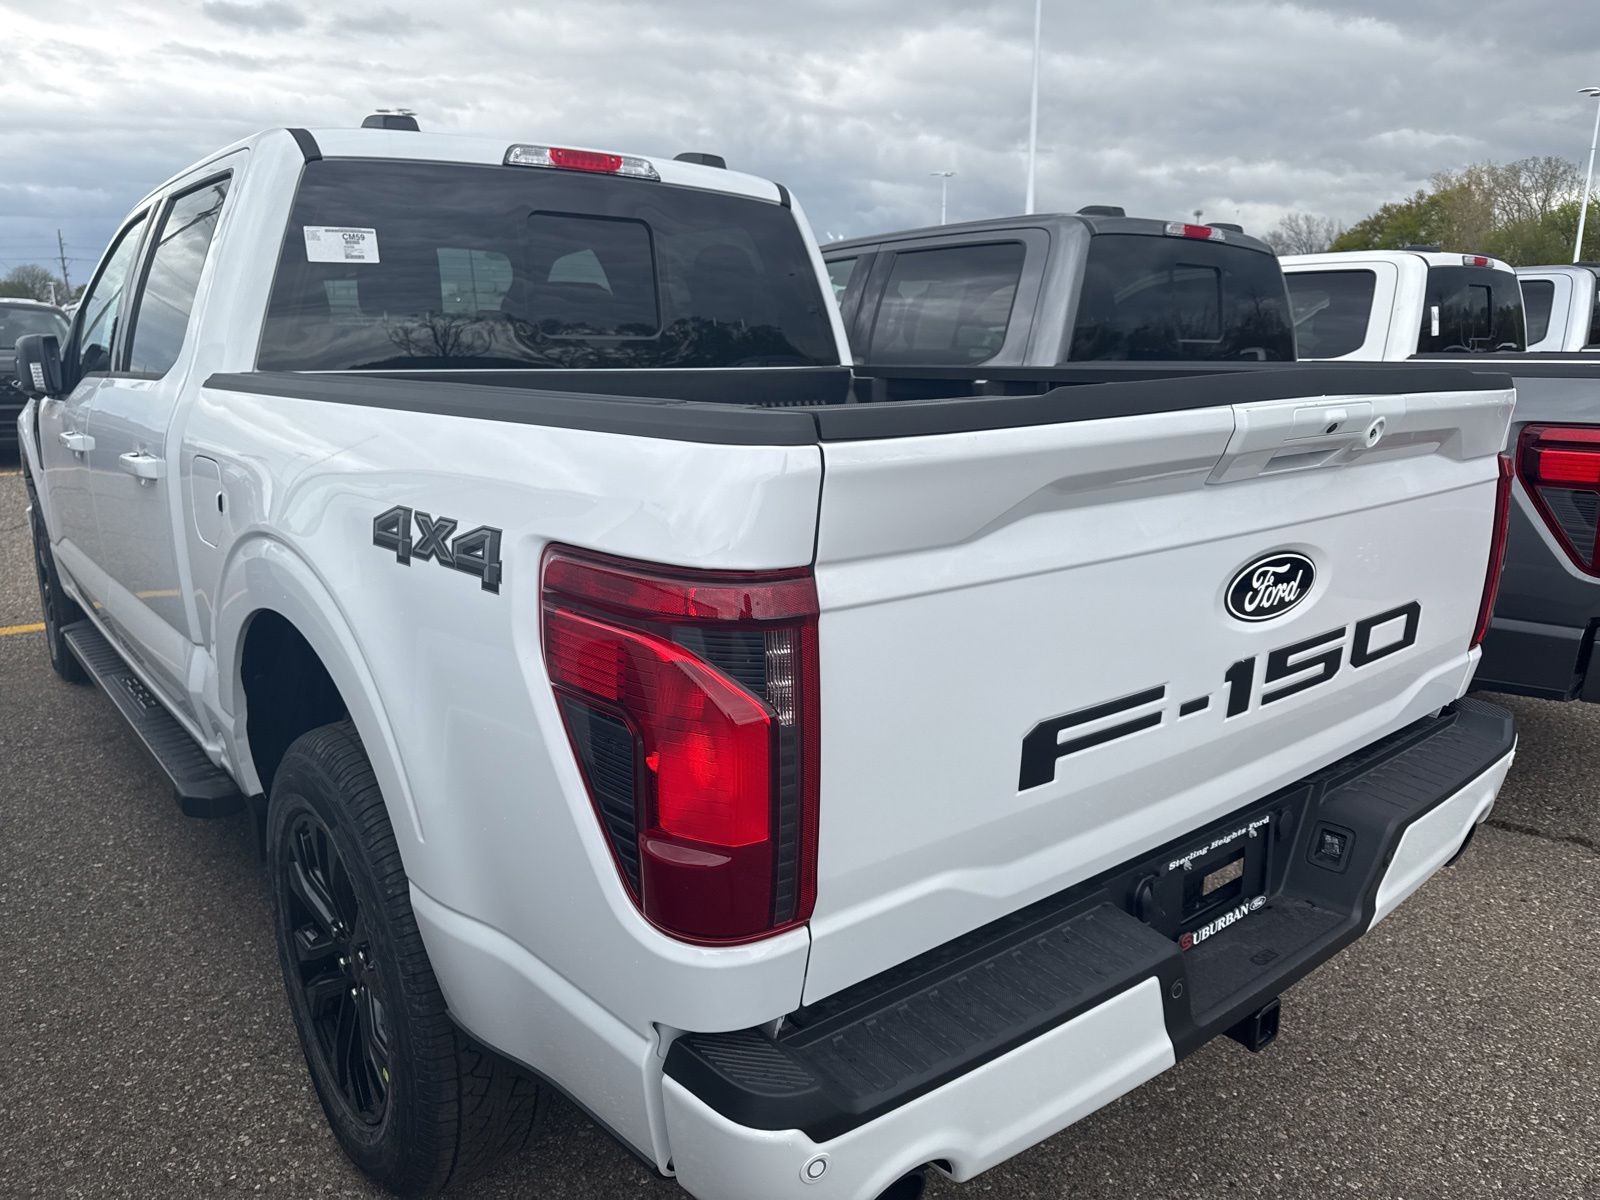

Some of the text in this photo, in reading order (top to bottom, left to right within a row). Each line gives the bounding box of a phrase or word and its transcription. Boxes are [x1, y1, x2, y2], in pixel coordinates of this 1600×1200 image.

[342, 233, 365, 241] CM59
[1244, 563, 1303, 613] Ford
[1017, 600, 1421, 792] F-150
[1168, 815, 1270, 871] Sterling Heights Ford
[1179, 903, 1249, 951] SUBURBAN
